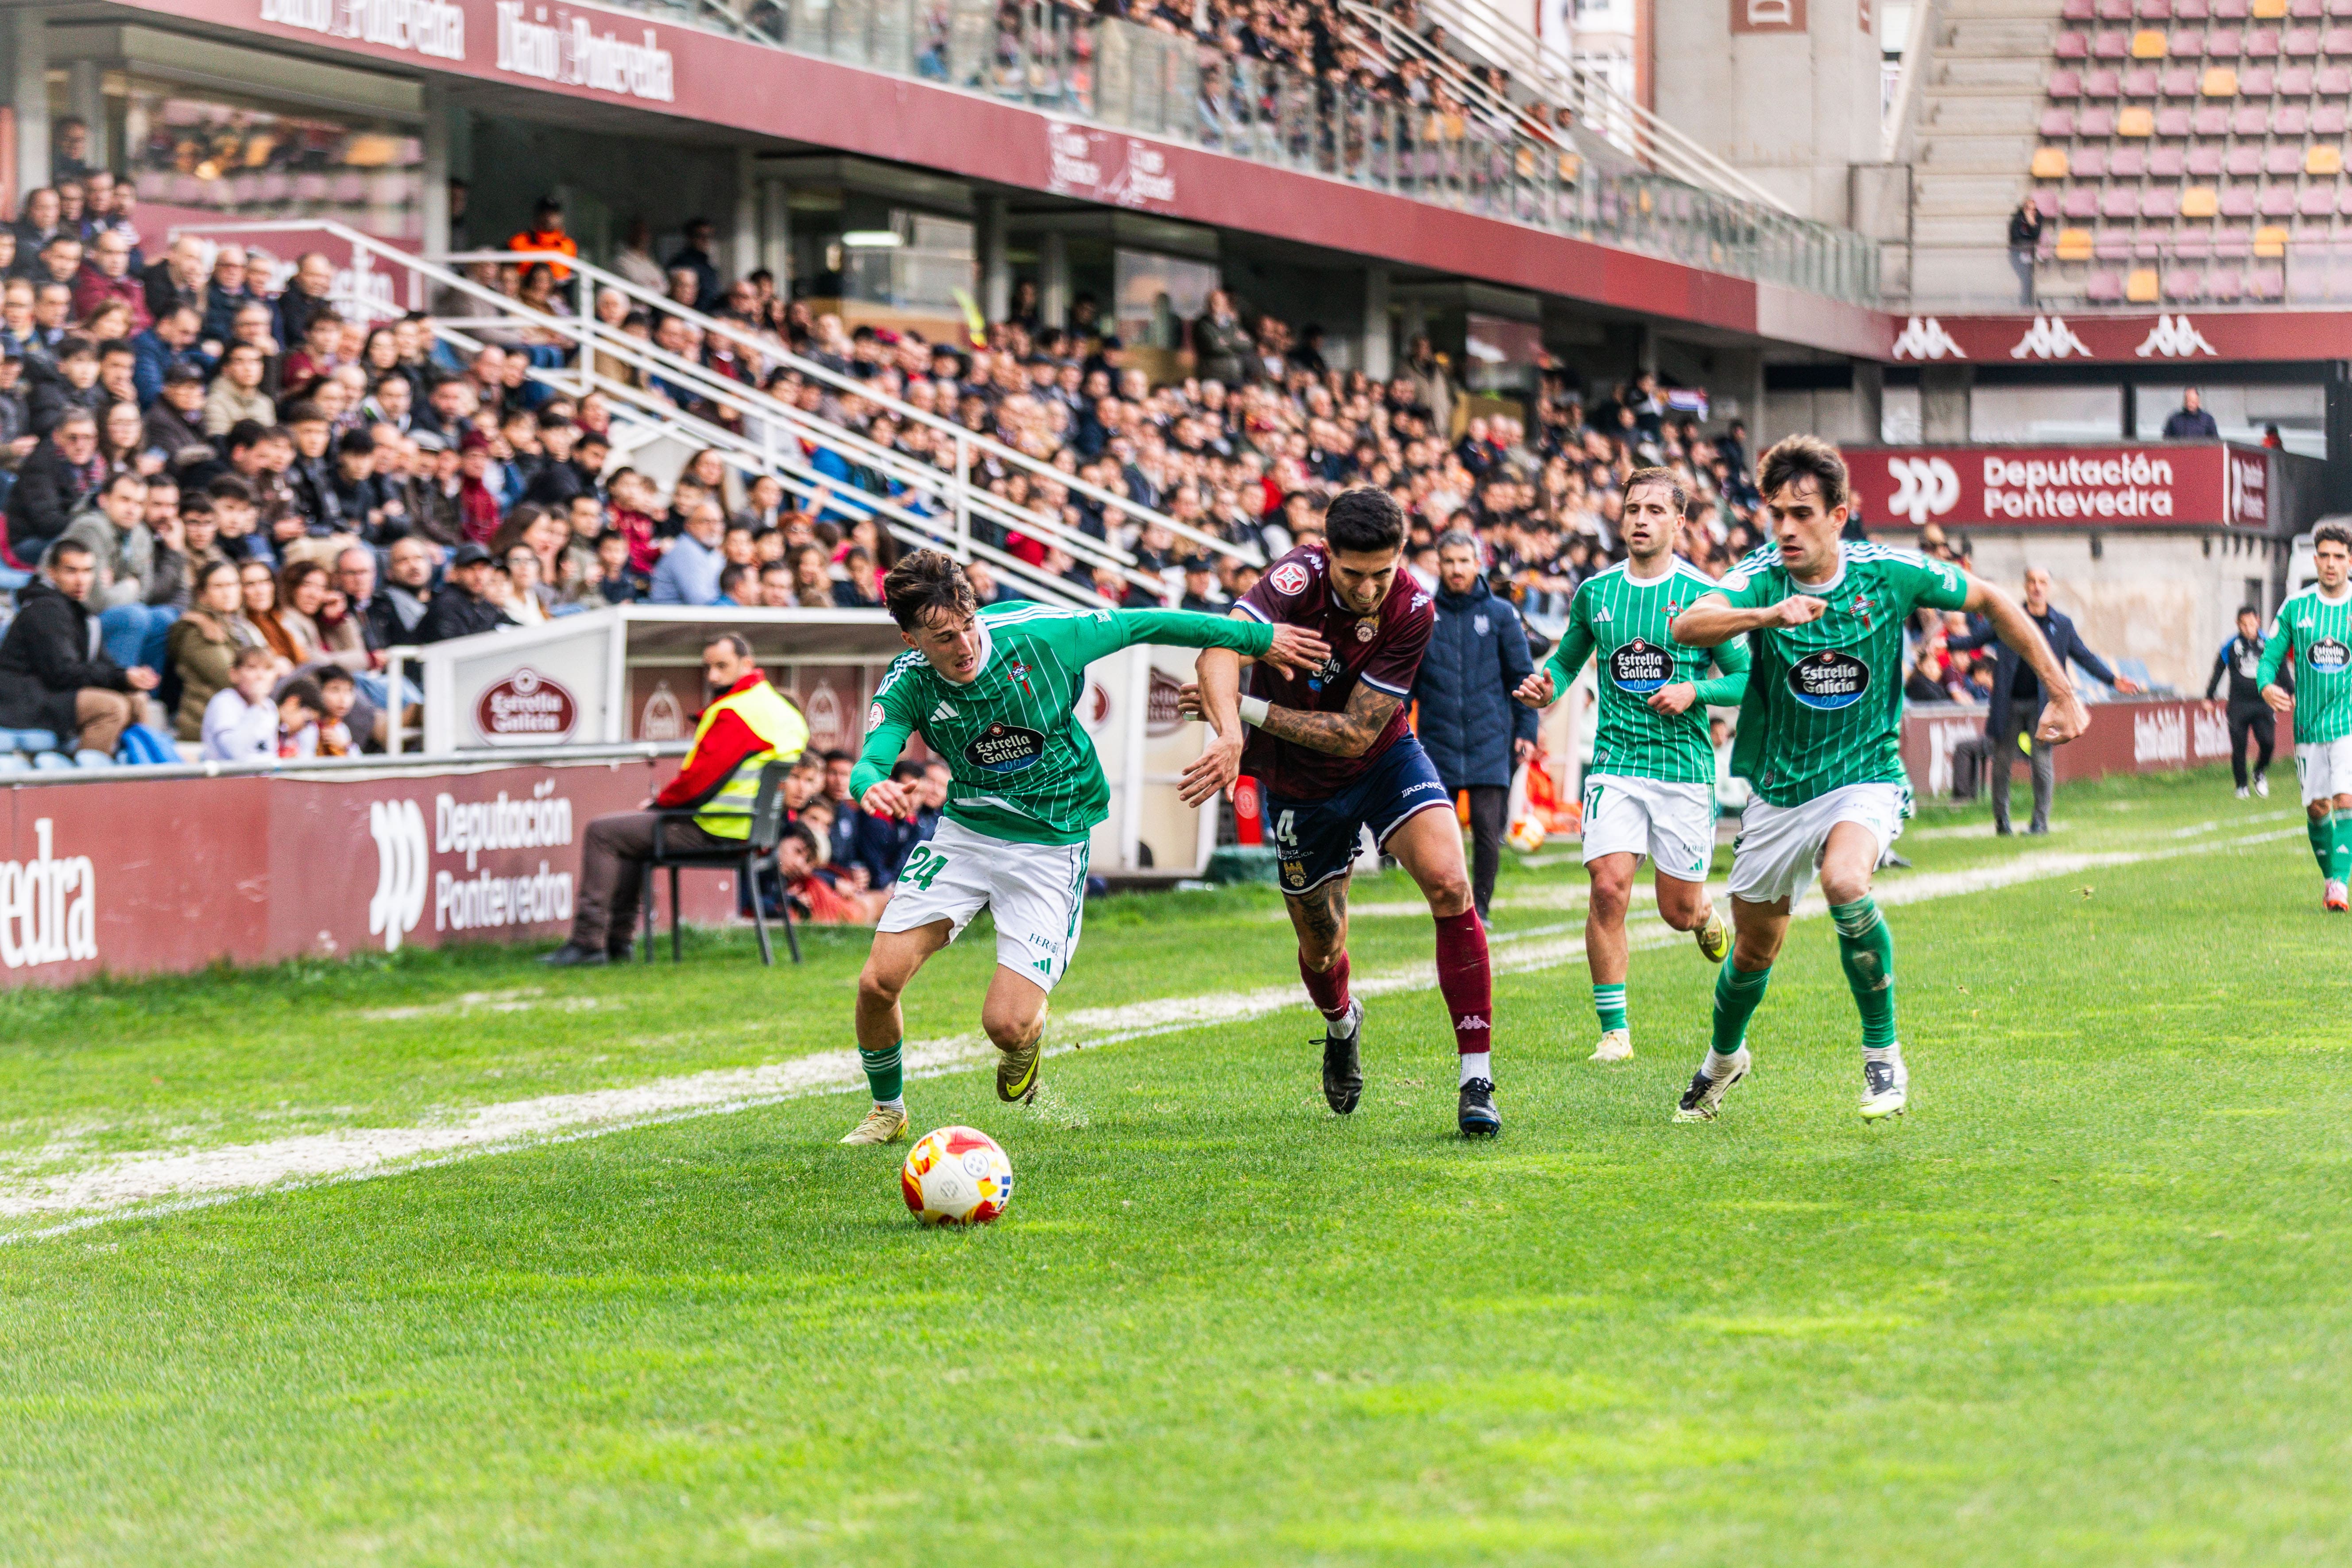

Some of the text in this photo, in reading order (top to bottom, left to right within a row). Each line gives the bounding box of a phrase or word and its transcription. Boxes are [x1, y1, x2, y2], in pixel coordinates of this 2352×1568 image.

[1983, 452, 2173, 494] Deputación
[1984, 484, 2173, 518] Pontevedra
[1617, 653, 1663, 666] Estrella
[1619, 666, 1662, 679] Galicia
[1800, 664, 1859, 680] Estrella
[1803, 678, 1857, 694] Galicia
[975, 735, 1031, 754] Estrella
[982, 747, 1034, 764] Galicia
[435, 777, 573, 872] Deputación
[1277, 809, 1298, 847] 4
[898, 846, 949, 891] 24
[435, 859, 574, 932] Pontevedra
